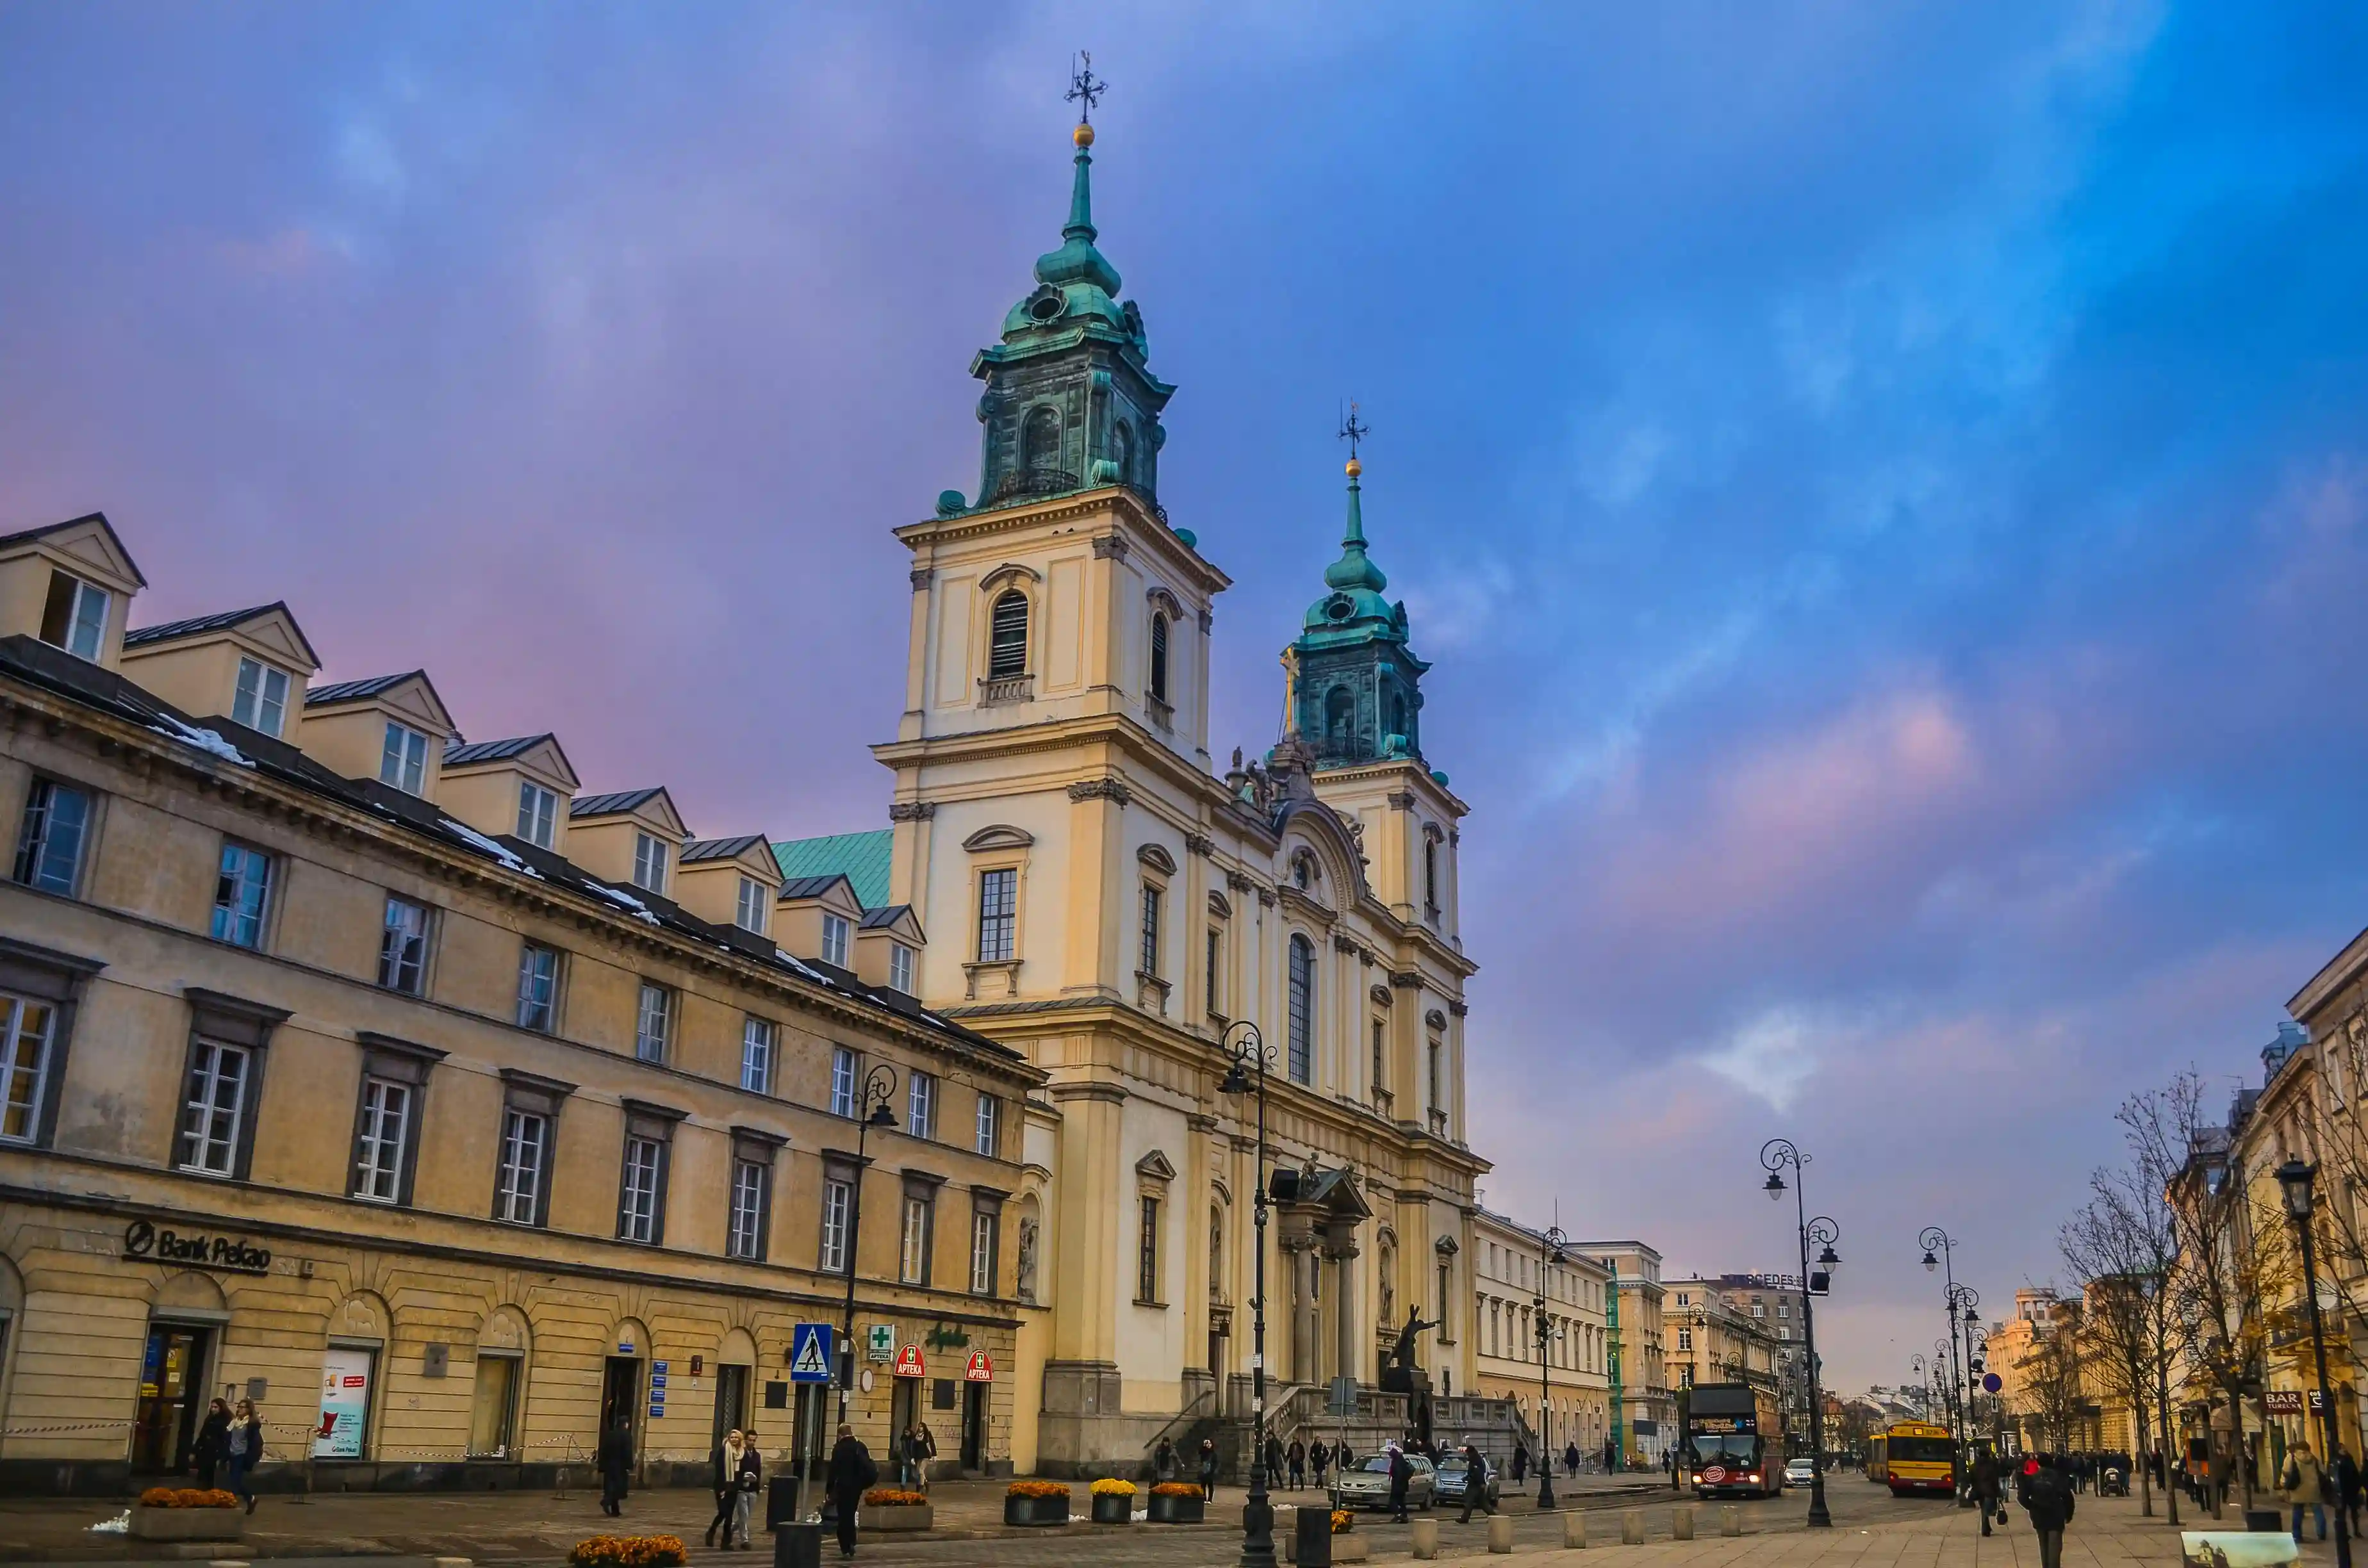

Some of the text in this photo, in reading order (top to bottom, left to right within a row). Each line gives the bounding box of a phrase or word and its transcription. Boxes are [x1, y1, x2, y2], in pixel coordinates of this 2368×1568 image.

[160, 1230, 272, 1268] Bank Pekao
[898, 1363, 923, 1375] APTEKA
[968, 1369, 990, 1380] APTEKA
[2265, 1393, 2298, 1403] BAR
